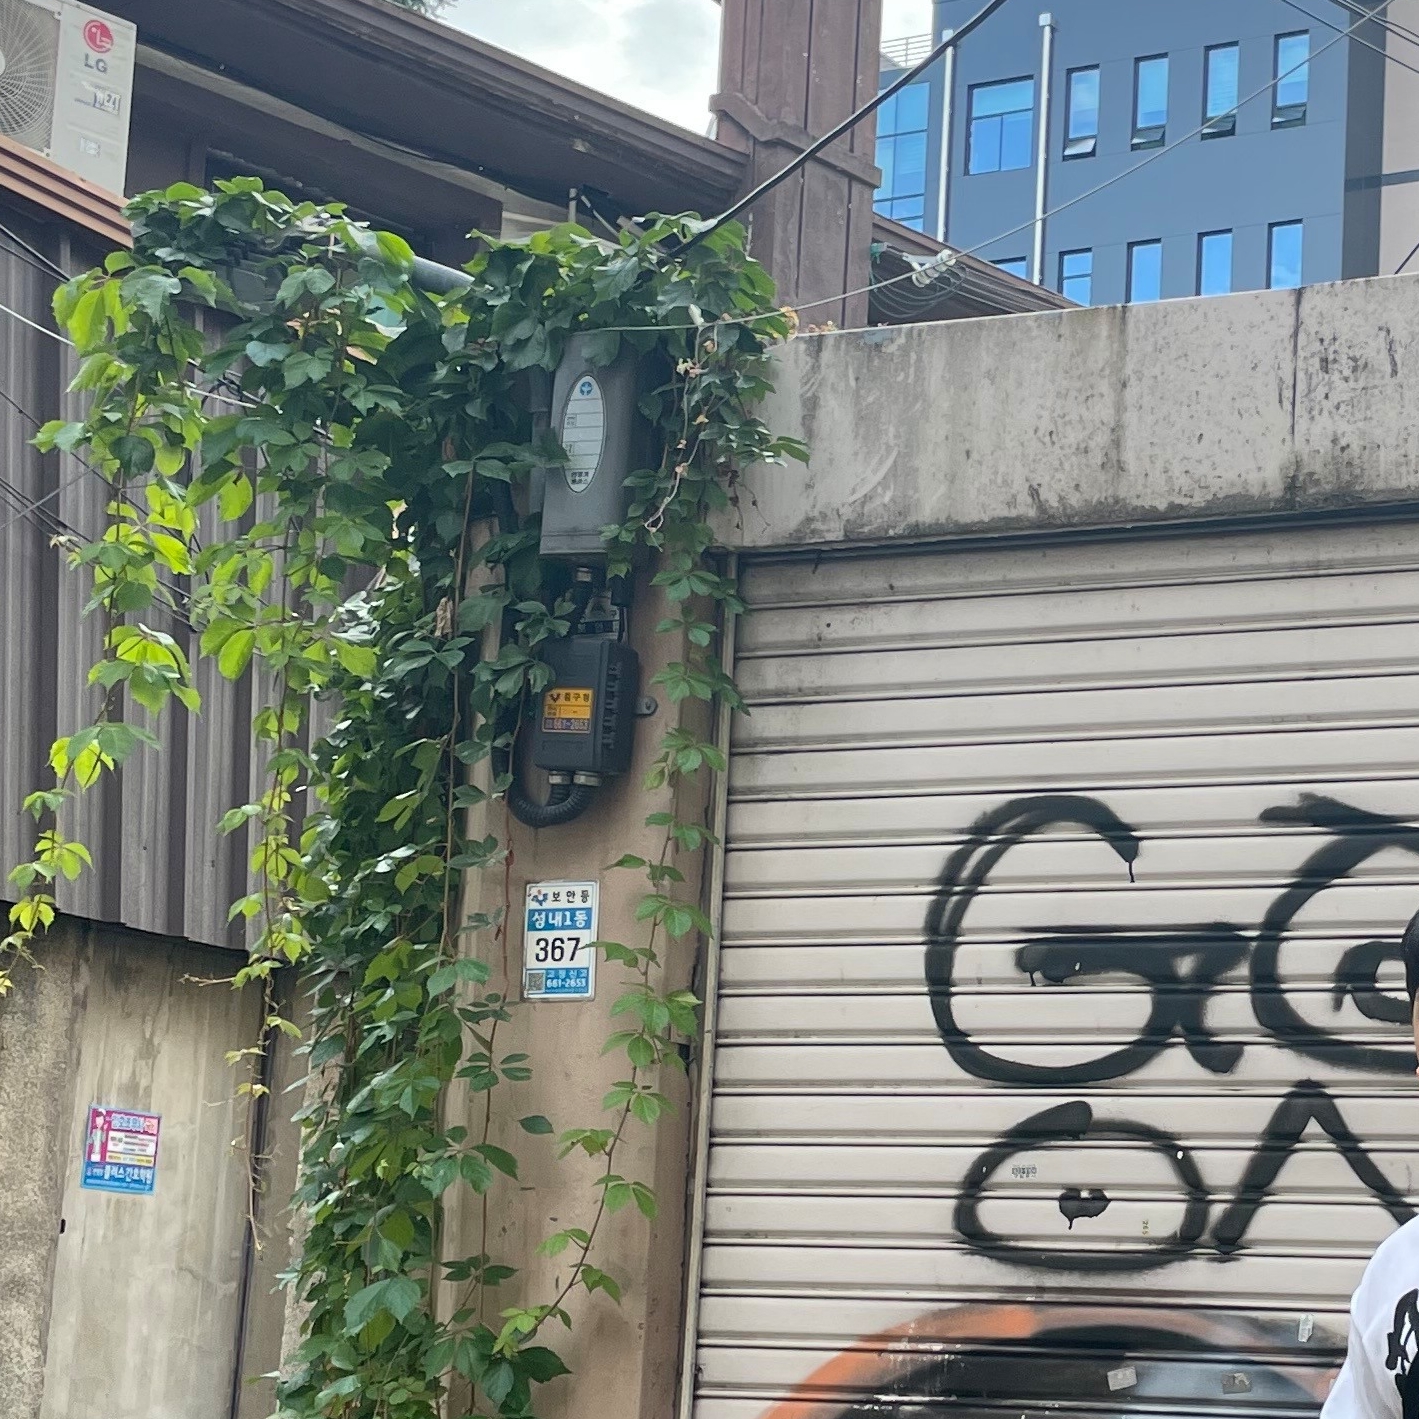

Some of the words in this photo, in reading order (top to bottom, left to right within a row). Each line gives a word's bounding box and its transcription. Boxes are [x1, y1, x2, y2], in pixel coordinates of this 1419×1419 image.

[84, 53, 108, 74] LG
[551, 889, 590, 904] 보안등
[531, 910, 588, 929] 성내1동
[535, 937, 581, 962] 367
